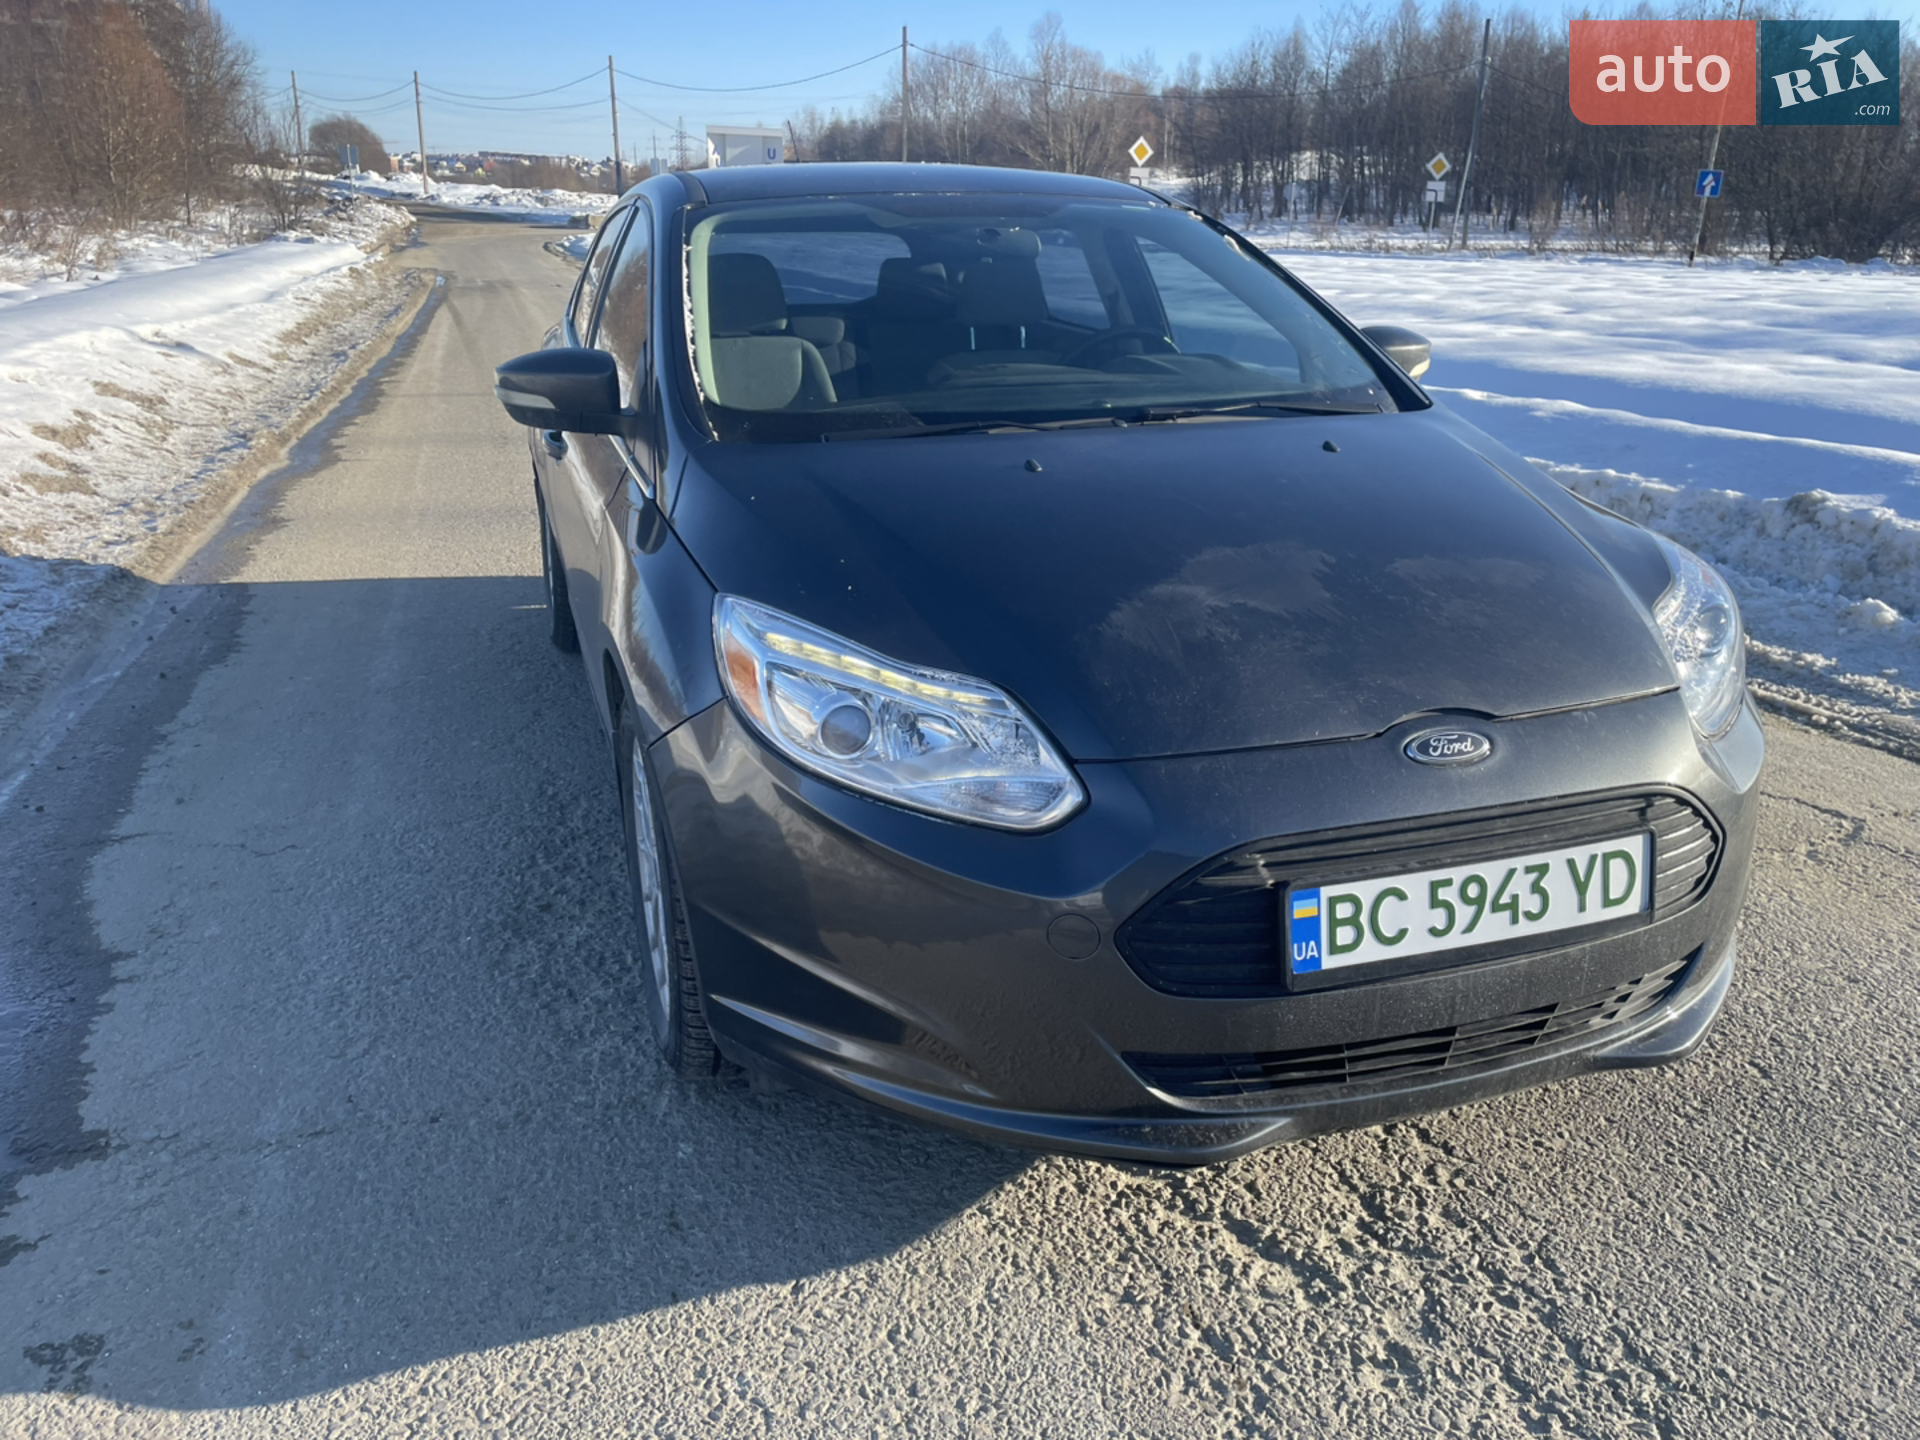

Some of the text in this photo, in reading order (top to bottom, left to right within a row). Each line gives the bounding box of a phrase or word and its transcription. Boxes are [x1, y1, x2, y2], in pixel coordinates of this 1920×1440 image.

[1429, 734, 1474, 756] Ford
[1327, 849, 1637, 956] BC 5943 YD
[1293, 940, 1319, 961] UA
